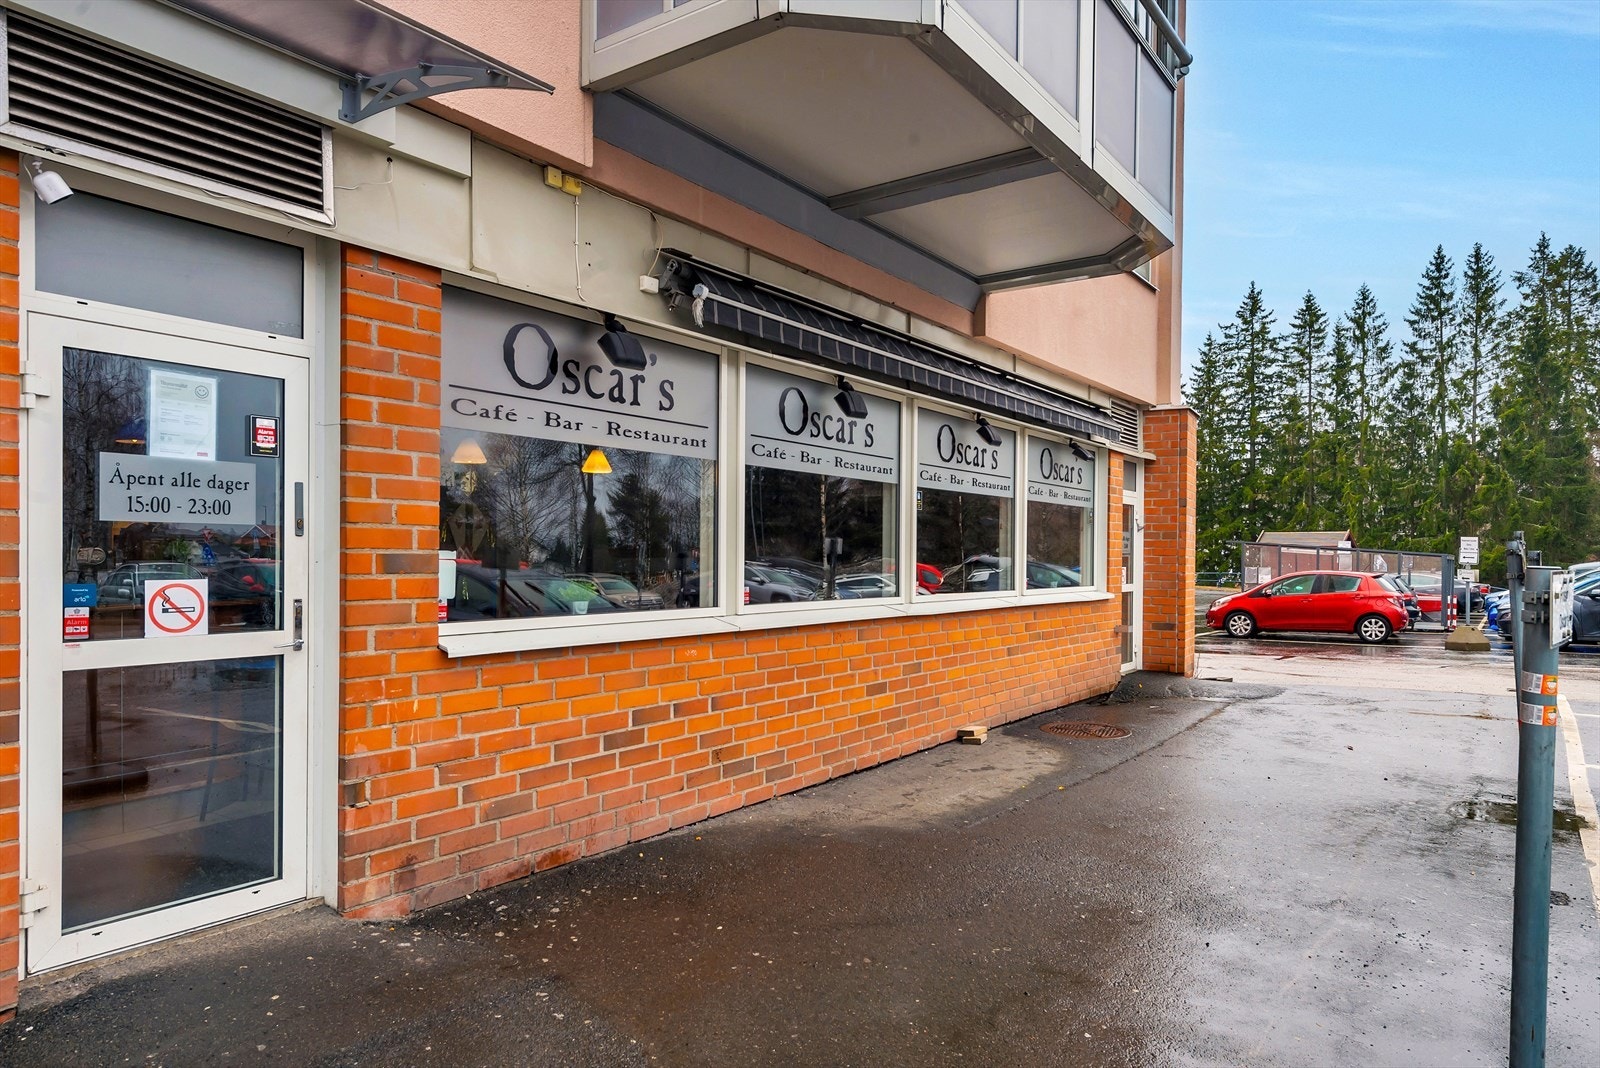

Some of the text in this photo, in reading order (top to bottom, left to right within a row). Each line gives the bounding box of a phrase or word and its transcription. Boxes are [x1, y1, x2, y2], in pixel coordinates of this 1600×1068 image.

[503, 322, 675, 412] Oscar's
[257, 428, 274, 436] Alarm
[450, 397, 518, 423] Café
[544, 411, 584, 431] Bar
[606, 420, 708, 448] Restaurant
[778, 386, 875, 448] Oscars
[751, 443, 787, 460] Café
[800, 450, 822, 466] Bar
[834, 456, 894, 475] Restaurant
[936, 423, 999, 470] Oscars
[108, 461, 250, 495] Åpent alle dager
[919, 469, 942, 483] Café
[950, 473, 965, 486] Bar
[972, 477, 1011, 492] Restaurant
[1040, 447, 1083, 485] Oscar's
[127, 495, 171, 514] 15:00
[188, 498, 232, 516] 23:00
[1048, 488, 1059, 498] Bar
[1063, 491, 1092, 503] Restaurant
[66, 618, 88, 626] Alarm
